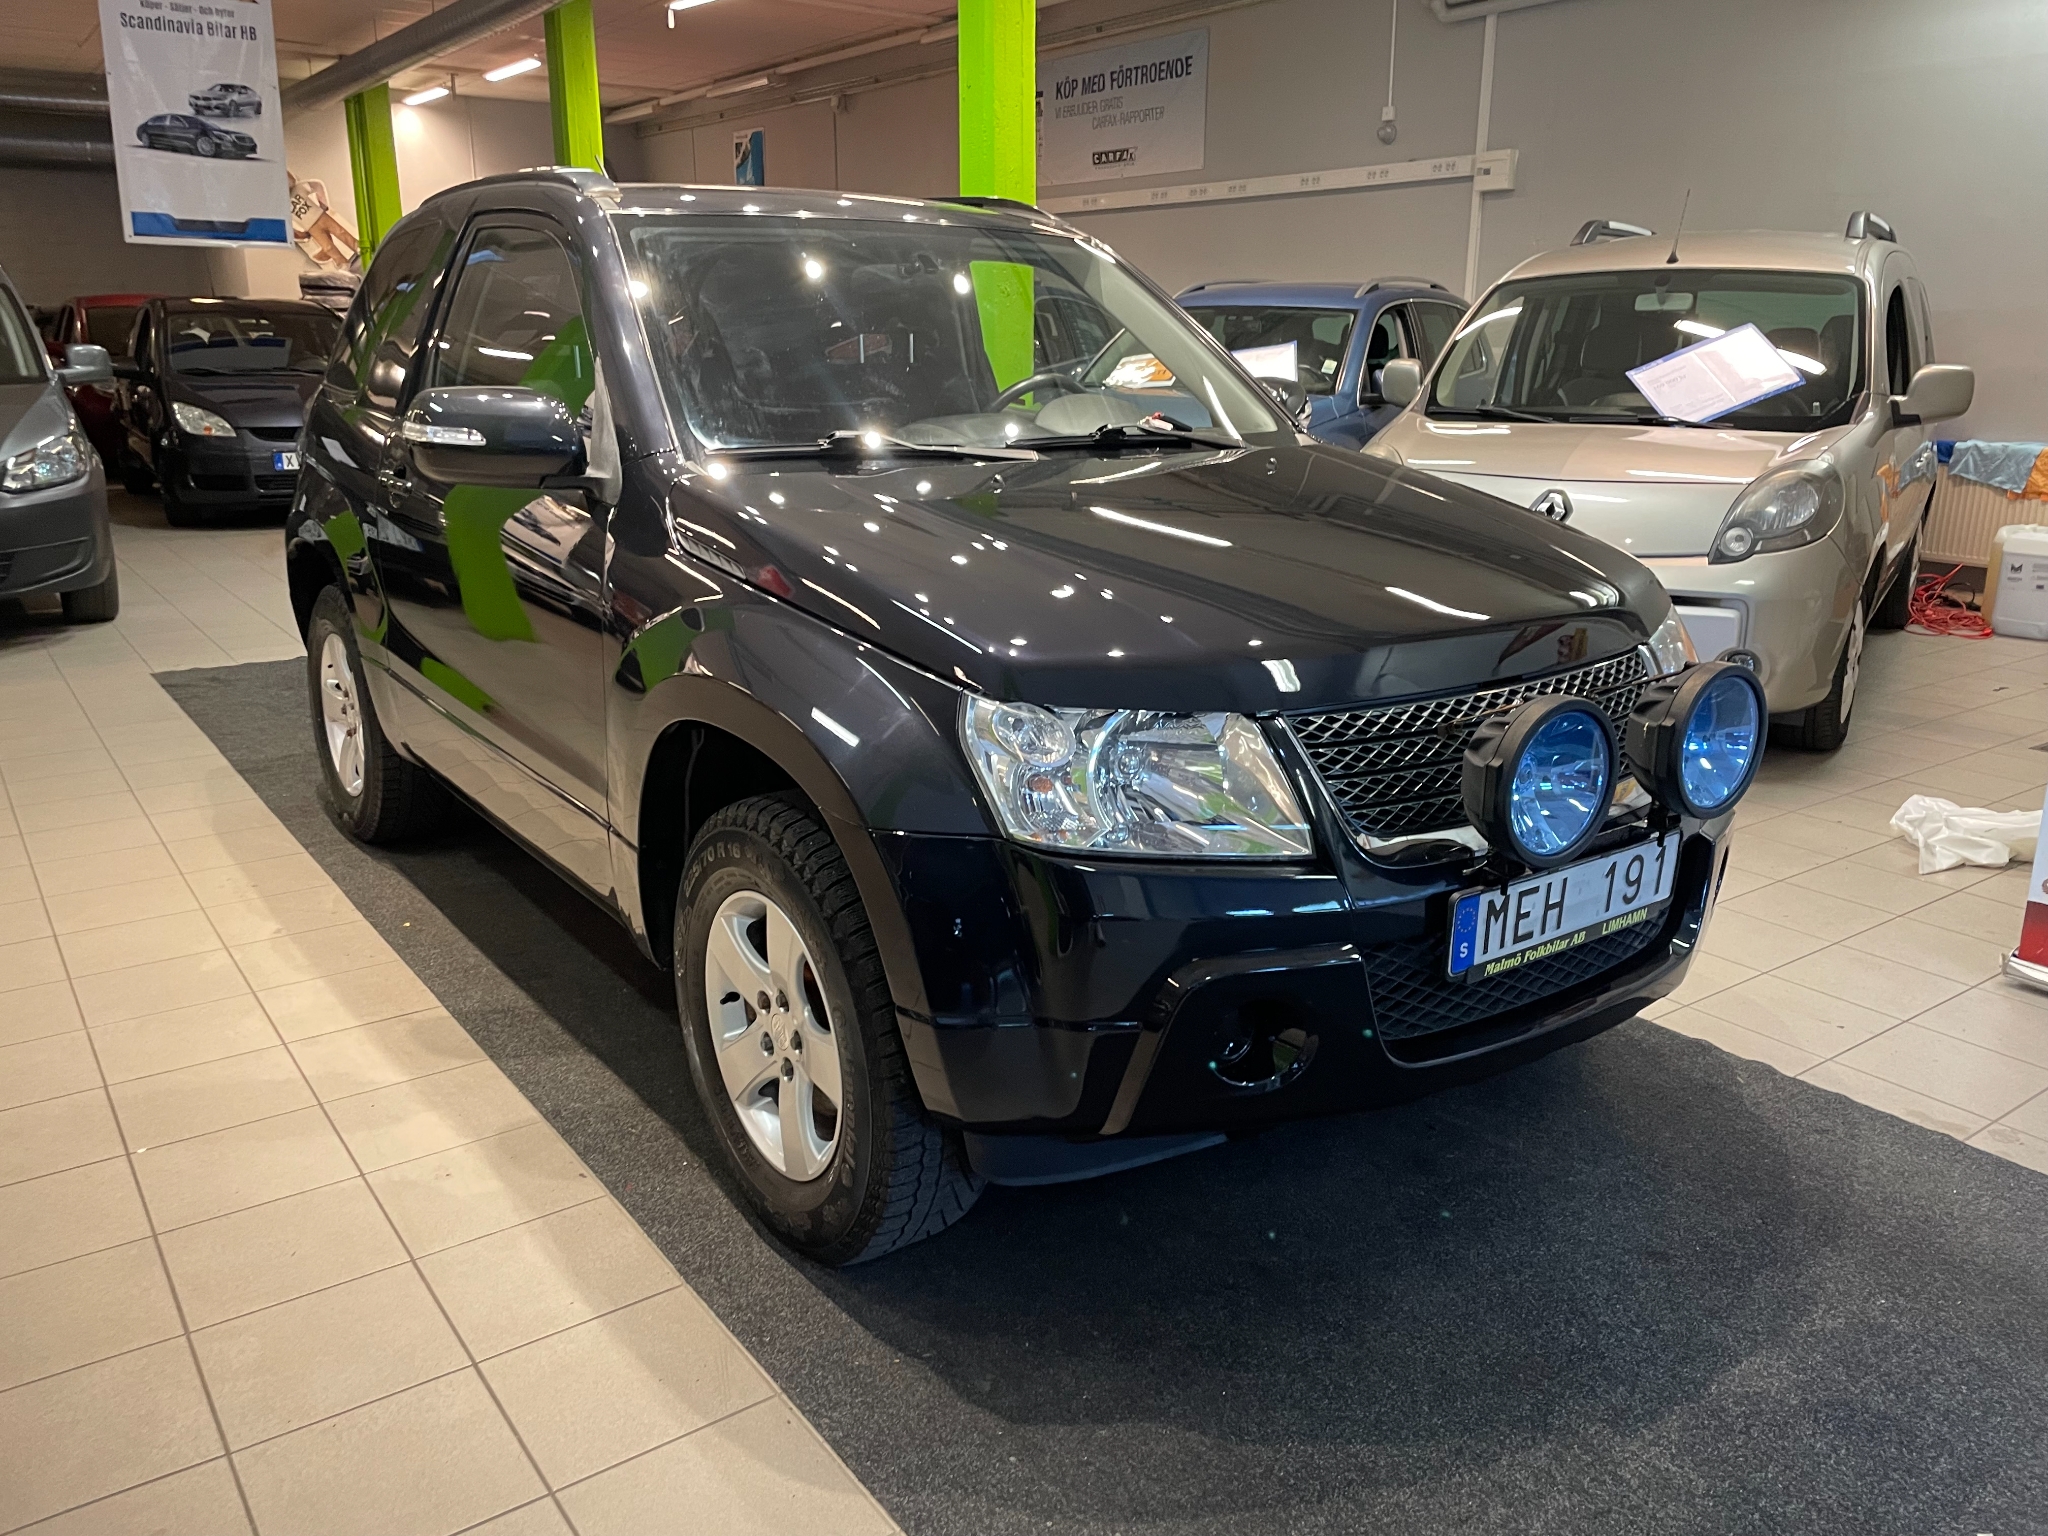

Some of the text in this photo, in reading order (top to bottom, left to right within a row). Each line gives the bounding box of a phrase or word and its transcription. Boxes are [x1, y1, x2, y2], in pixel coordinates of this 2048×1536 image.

[119, 12, 258, 42] Scandinavia Bilar HB
[1055, 54, 1194, 101] KÖP MED FÖRTROENDE
[1092, 148, 1136, 166] CARFAX
[296, 200, 313, 221] FOX
[1482, 845, 1667, 956] MEH 191
[1484, 907, 1648, 977] Malmö Folkbilar AB LIMHAMN
